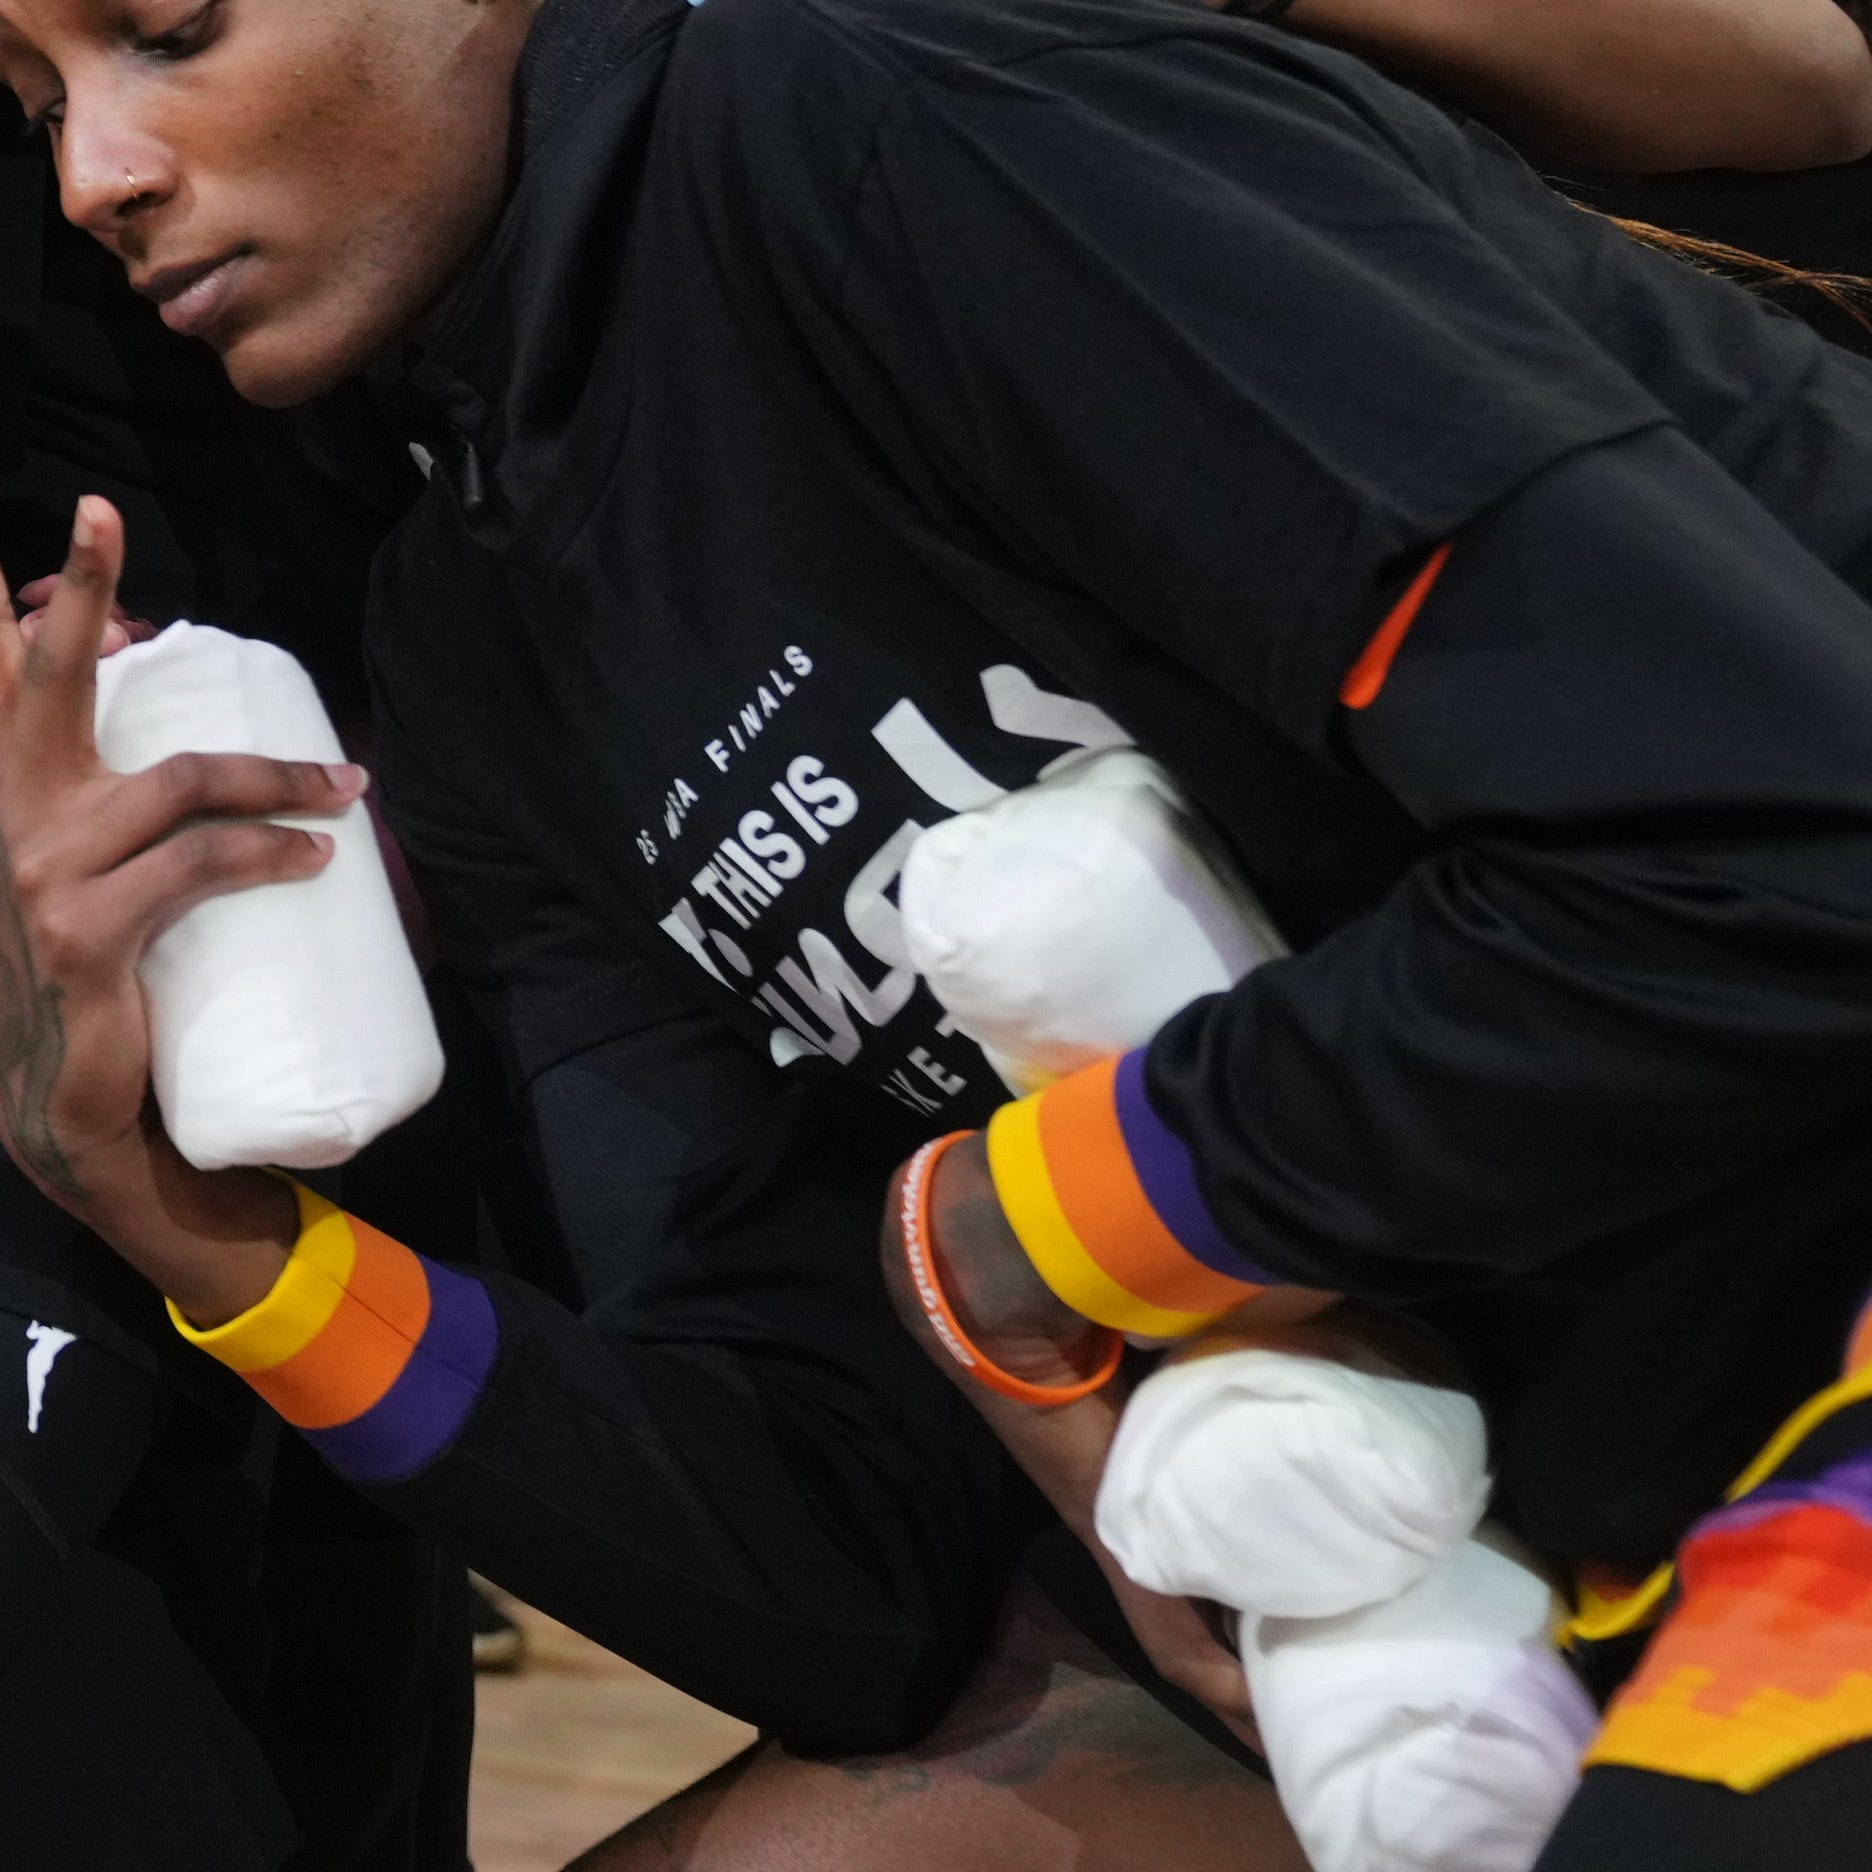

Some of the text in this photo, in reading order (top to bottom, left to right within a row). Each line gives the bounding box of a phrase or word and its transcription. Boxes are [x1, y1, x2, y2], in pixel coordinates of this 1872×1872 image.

[703, 645, 814, 773] FINALS
[691, 755, 860, 930] THIS IS
